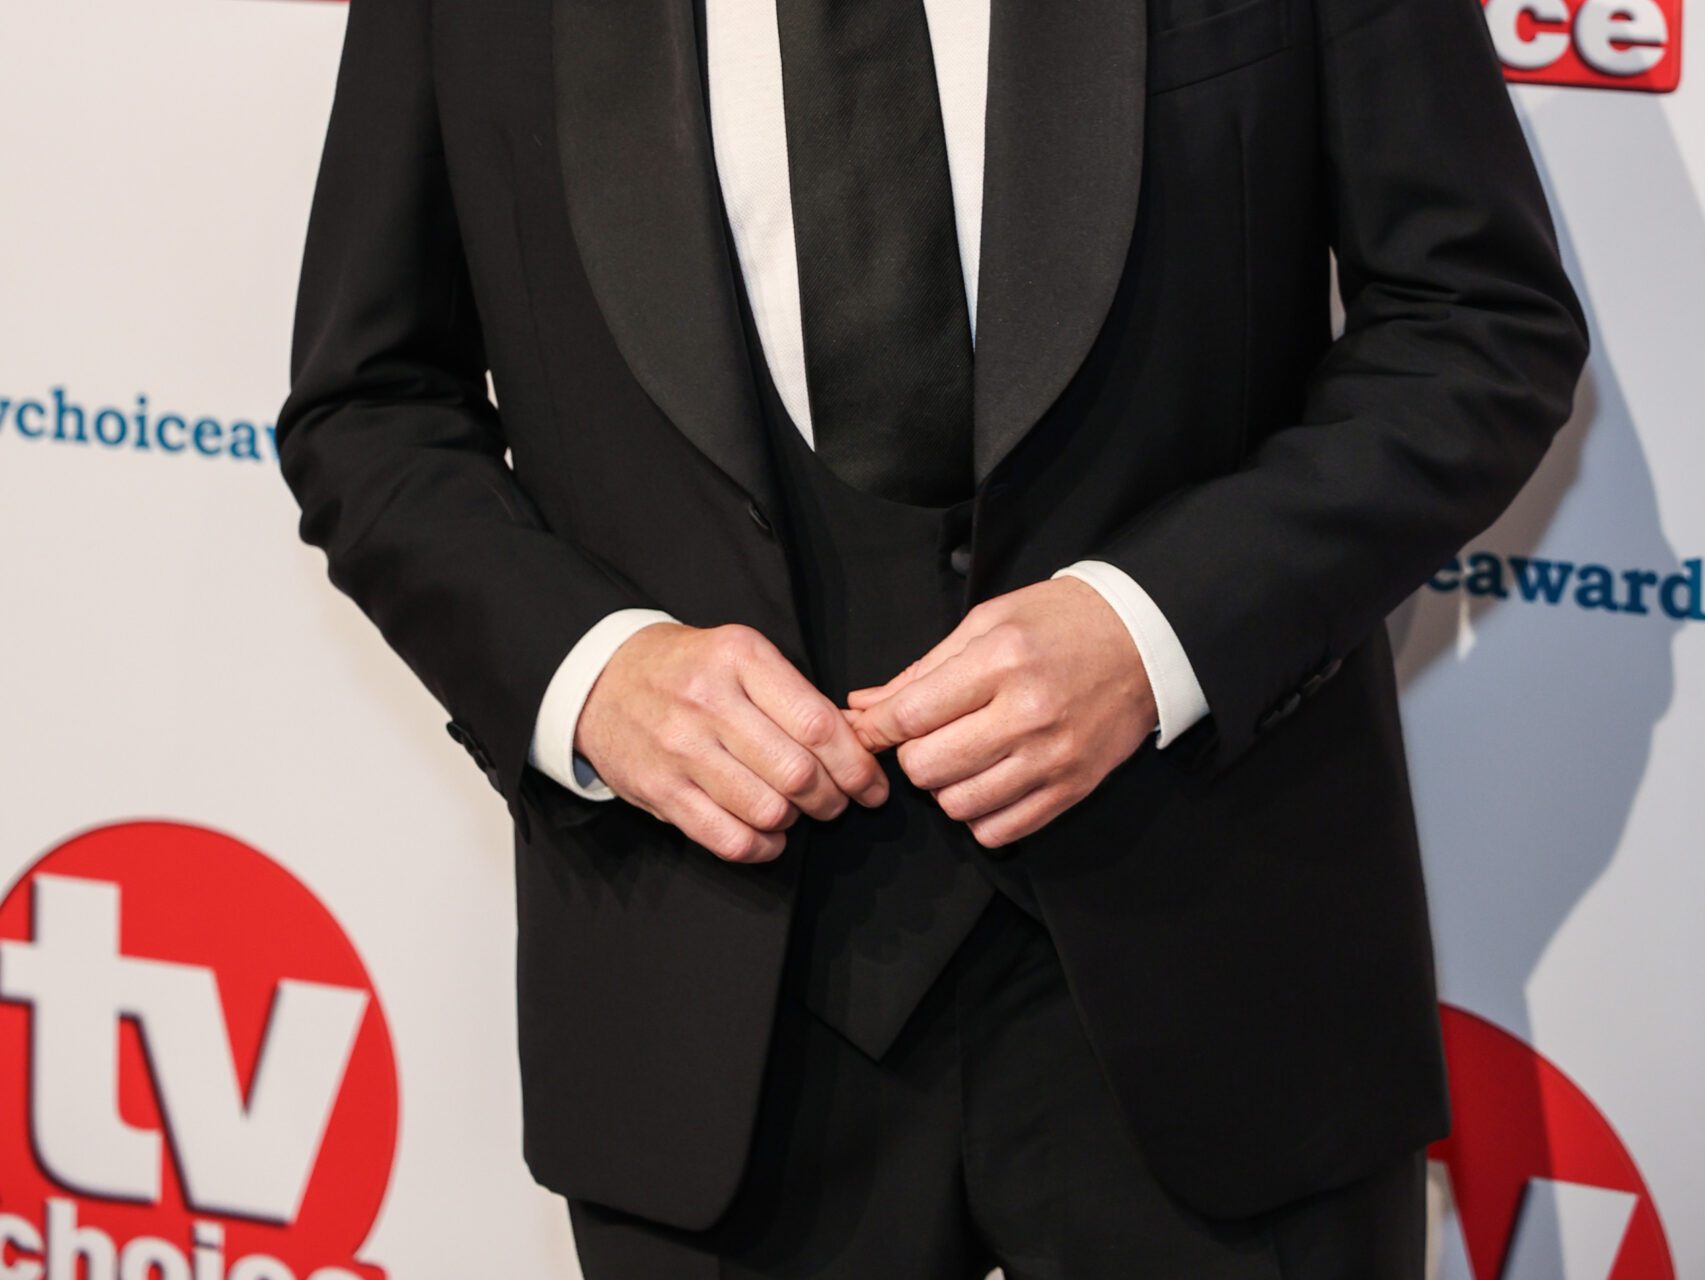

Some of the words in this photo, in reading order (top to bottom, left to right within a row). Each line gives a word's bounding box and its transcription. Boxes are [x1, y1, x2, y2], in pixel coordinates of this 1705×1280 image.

[0, 387, 281, 462] choicea
[0, 872, 370, 1224] tv
[0, 1198, 366, 1280] choi
